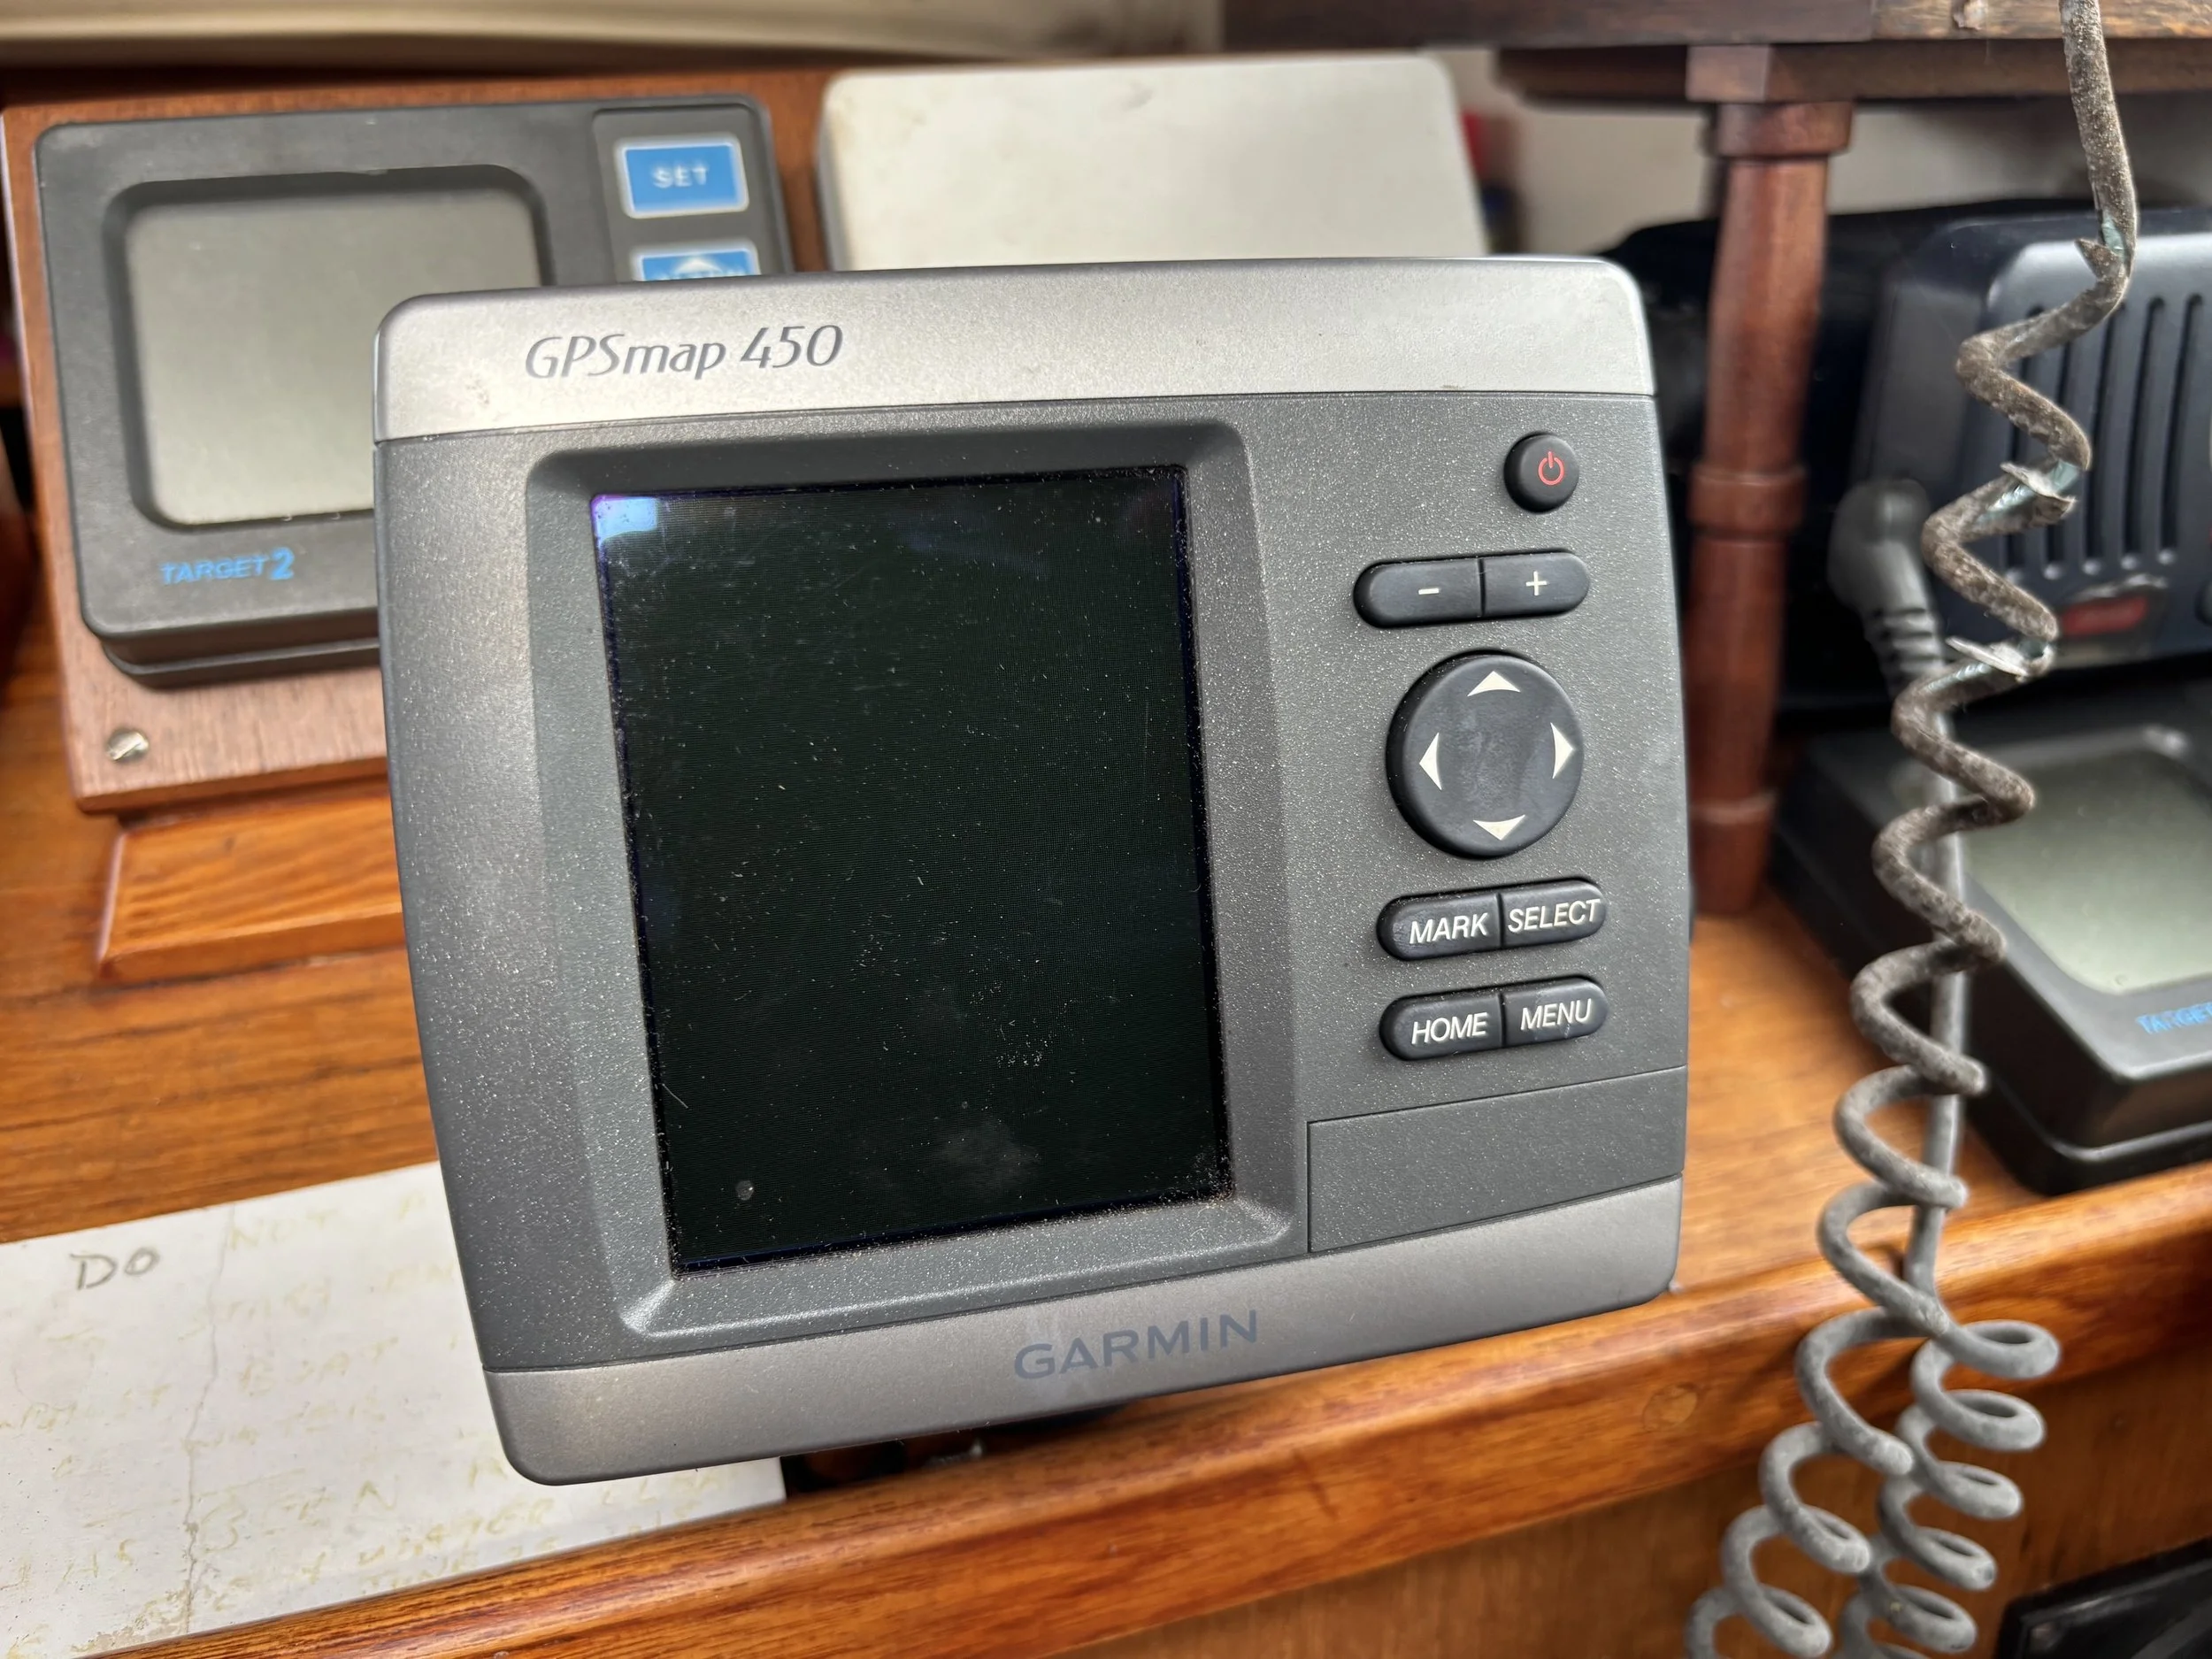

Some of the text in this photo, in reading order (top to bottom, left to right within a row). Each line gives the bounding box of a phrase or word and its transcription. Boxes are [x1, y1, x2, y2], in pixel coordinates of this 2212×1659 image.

[653, 162, 709, 188] SET
[526, 325, 842, 379] GPSmap 450
[1409, 913, 1488, 944] MARK
[1508, 899, 1600, 933] SELECT
[1411, 1012, 1488, 1045] HOME
[1521, 999, 1592, 1031] MENU
[70, 1247, 160, 1290] DO
[1015, 1310, 1256, 1379] GARMIN
